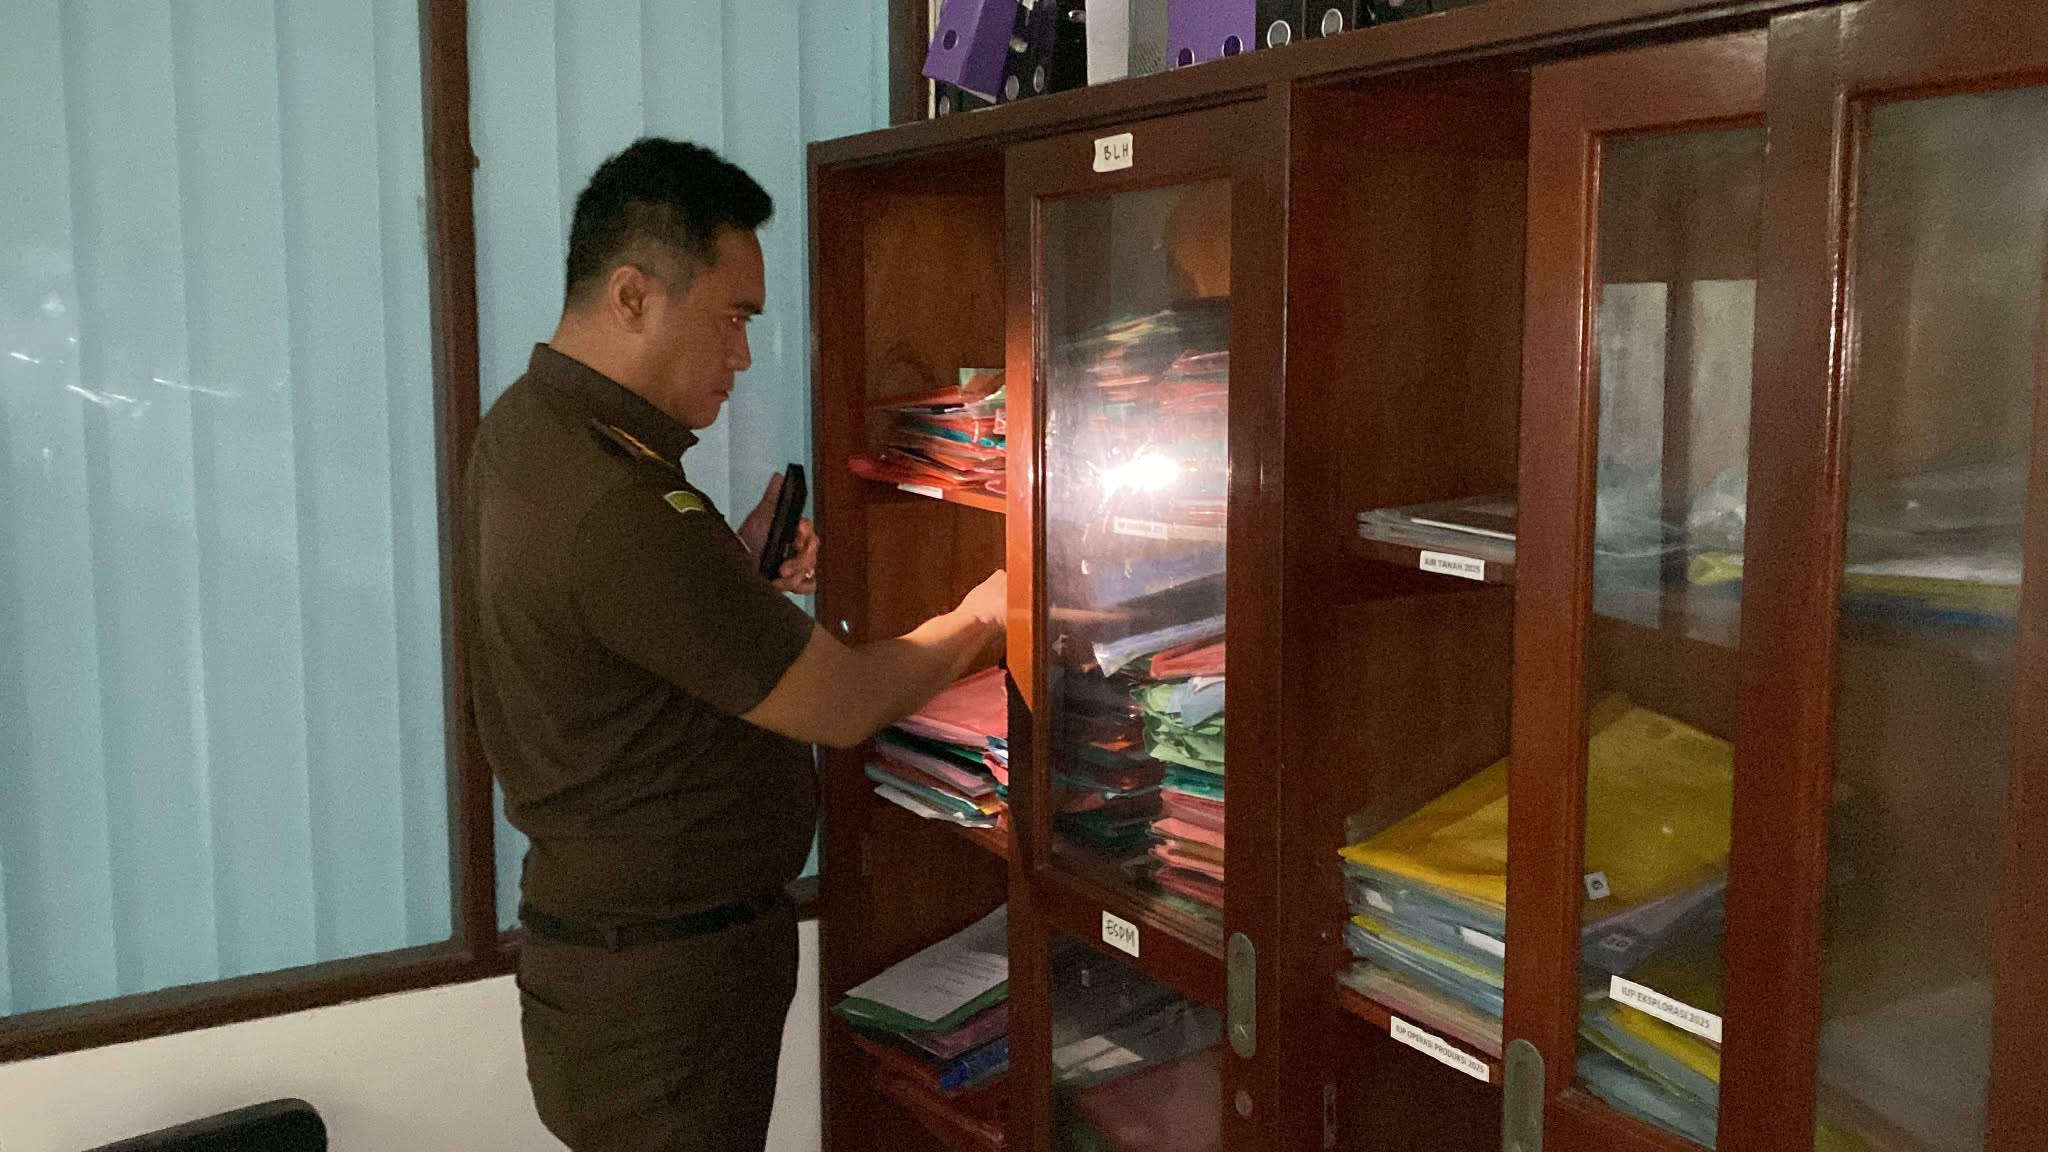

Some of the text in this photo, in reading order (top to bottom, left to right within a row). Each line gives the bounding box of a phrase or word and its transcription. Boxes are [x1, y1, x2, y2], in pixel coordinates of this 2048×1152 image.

[1104, 144, 1128, 160] BLH
[1424, 557, 1481, 574] AIR TANAH 2025
[1105, 919, 1135, 948] ESDM
[1622, 987, 1710, 1028] IUP EKSPLORASI 2025
[1396, 1025, 1484, 1073] IUP OPERASI PRODUKSI 2025
